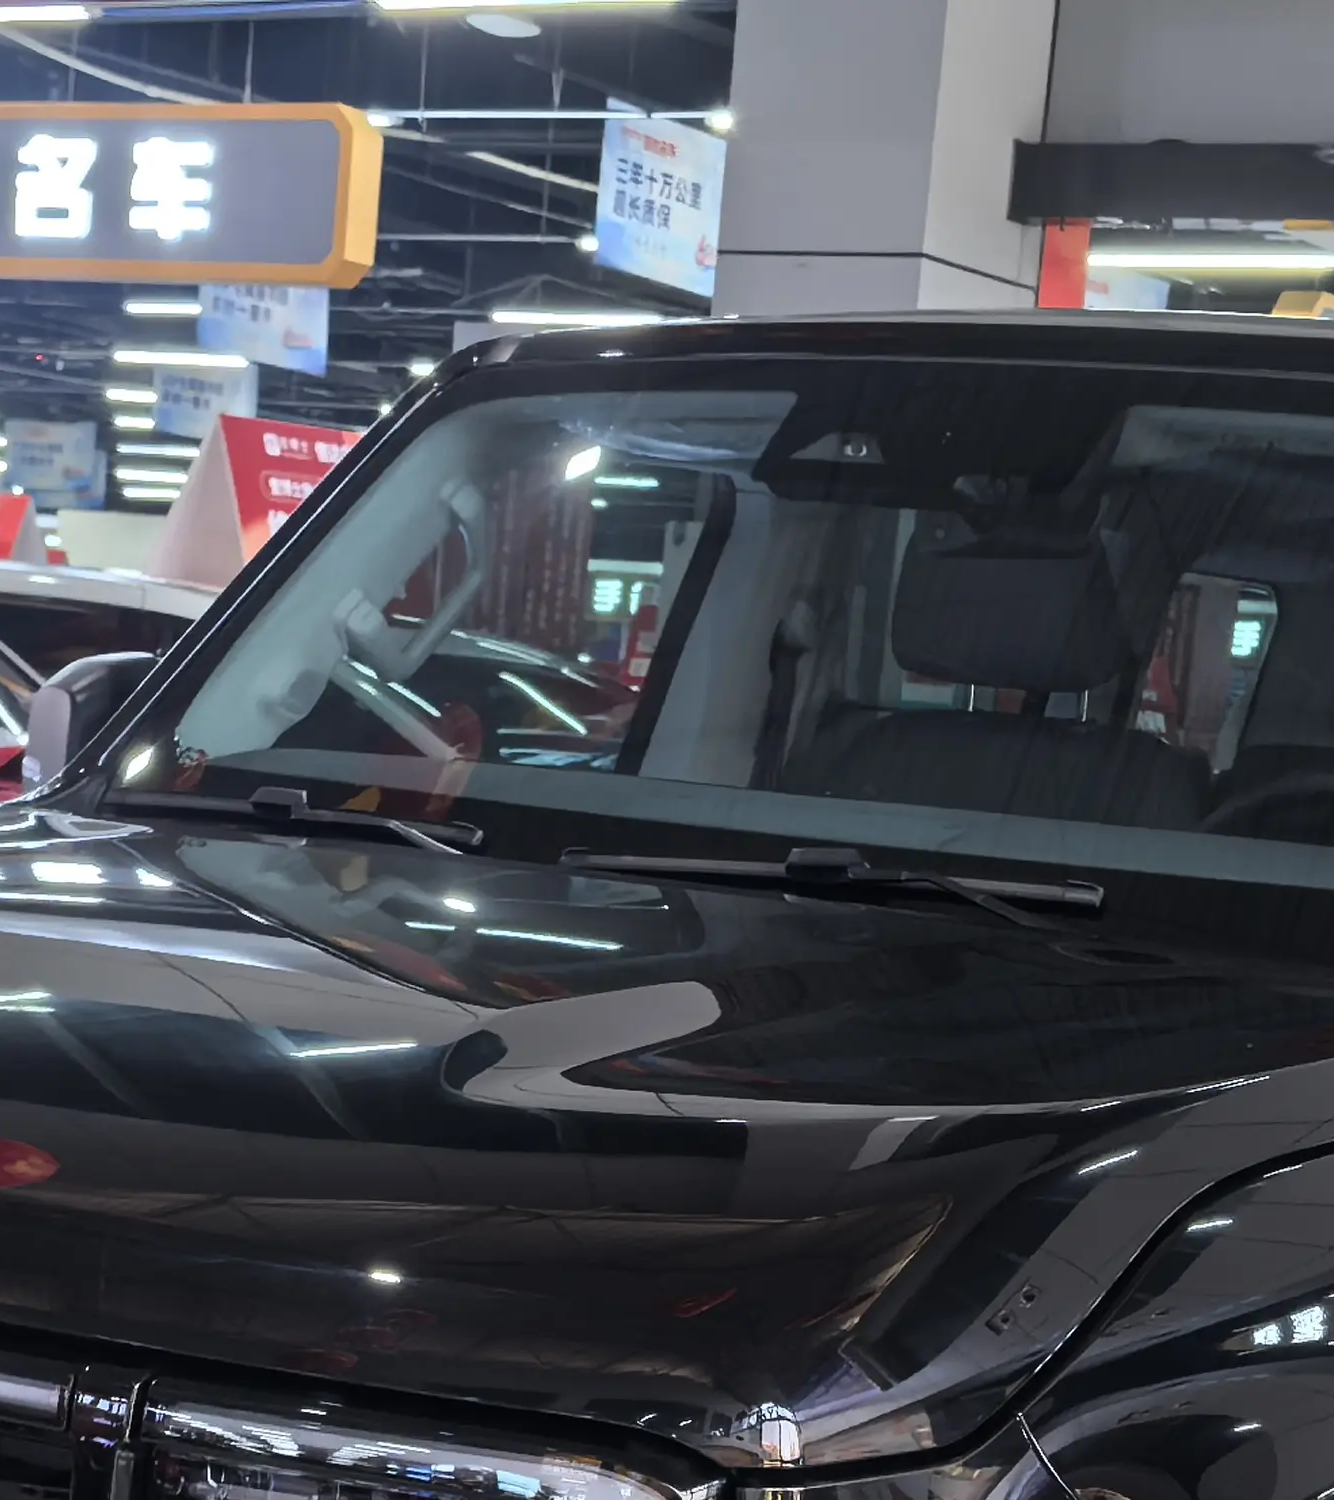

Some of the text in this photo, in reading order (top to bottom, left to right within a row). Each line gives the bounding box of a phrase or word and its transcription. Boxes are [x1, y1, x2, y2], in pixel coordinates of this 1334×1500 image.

[615, 158, 702, 211] 三年十万公里
